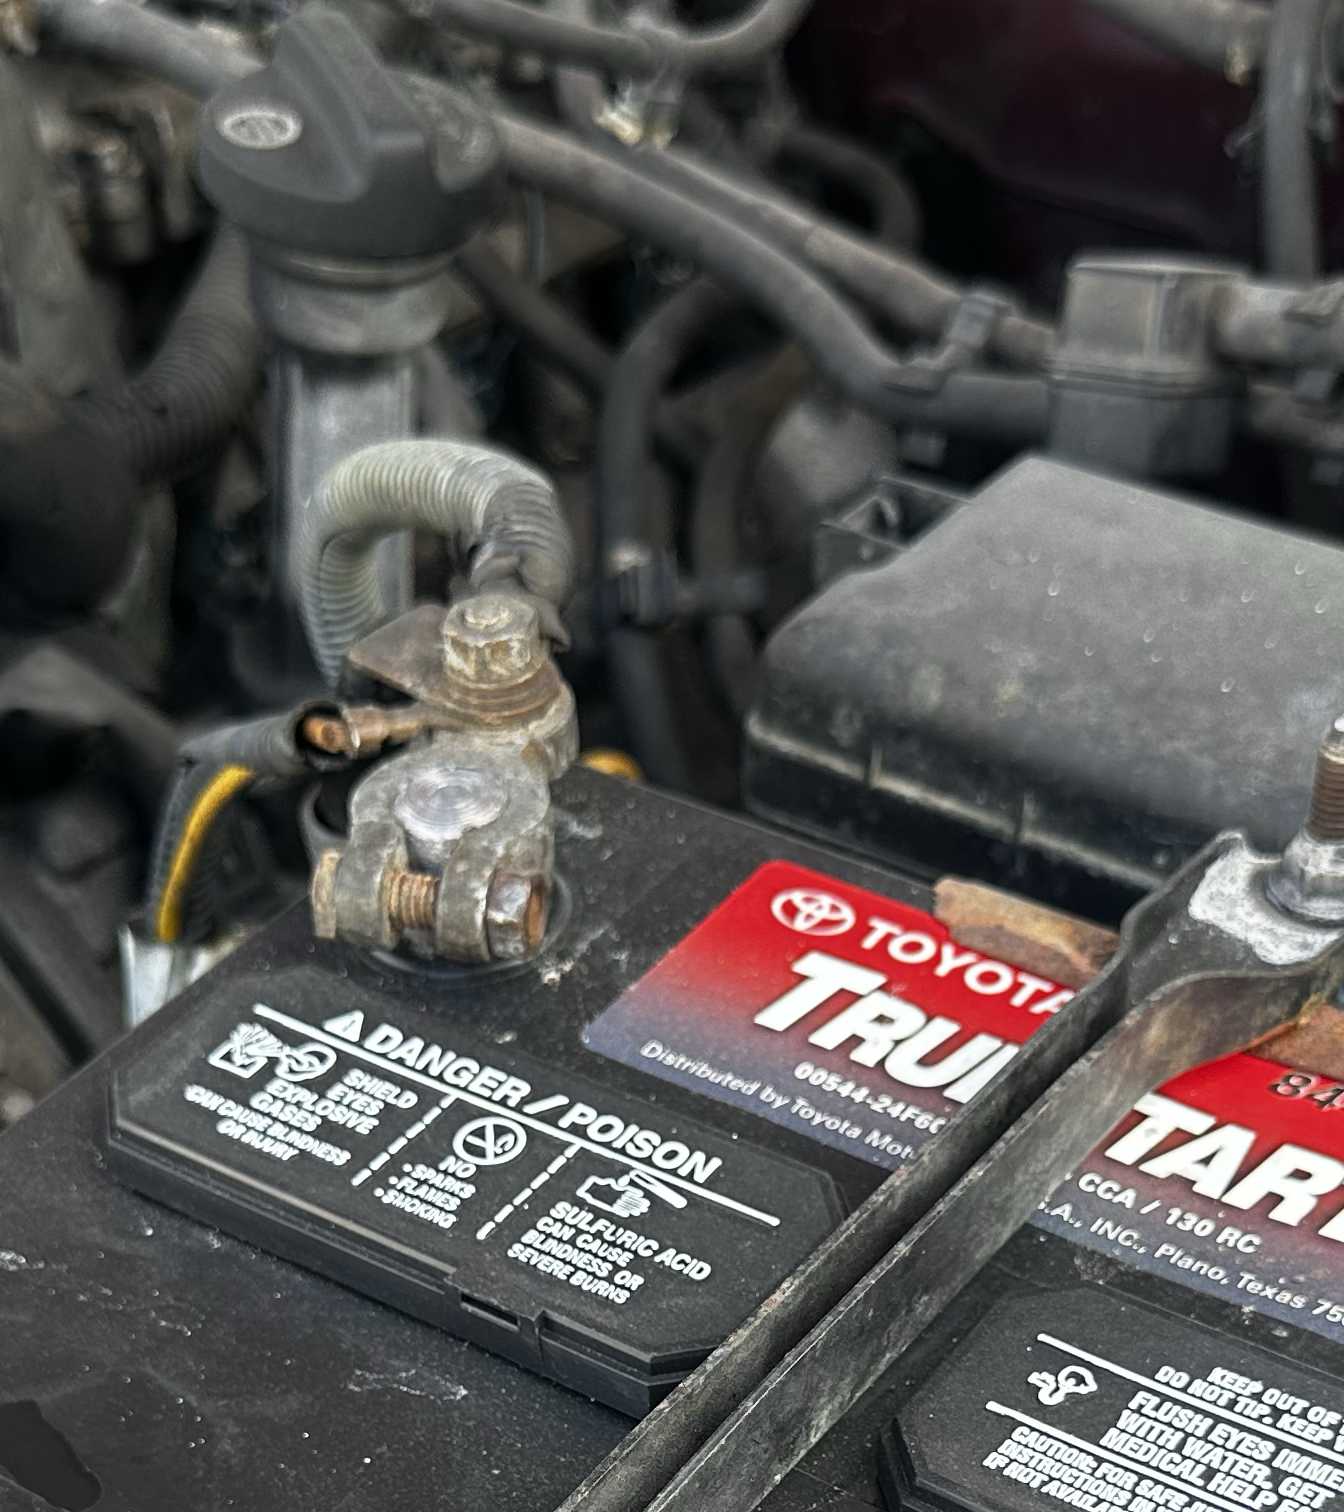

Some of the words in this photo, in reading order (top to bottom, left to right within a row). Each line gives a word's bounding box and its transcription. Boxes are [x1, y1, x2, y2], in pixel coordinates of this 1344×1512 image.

[249, 1091, 322, 1131] GASES
[265, 1078, 379, 1135] EXPLOSIVE
[325, 1082, 385, 1116] EYES
[342, 1068, 418, 1108] SHIELD
[363, 1023, 532, 1109] DANGER
[557, 1102, 723, 1183] POISON
[183, 1084, 222, 1110] CAN
[217, 1098, 272, 1134] CAUSE
[267, 1122, 352, 1166] BLINDNESS
[217, 1118, 242, 1140] OR
[241, 1131, 300, 1161] INJURY
[396, 1176, 461, 1211] FLAMES
[412, 1164, 476, 1199] SPARKS
[438, 1154, 477, 1178] NO
[640, 1039, 762, 1096] Distributed
[760, 1084, 790, 1110] by
[790, 1097, 864, 1139] Toyota
[1154, 1242, 1231, 1285] Plano,
[1236, 1270, 1307, 1310] Texas
[536, 1216, 574, 1240] CAN
[575, 1233, 634, 1268] CAUSE
[550, 1201, 659, 1257] SULFURIC
[654, 1248, 711, 1280] ACID
[1078, 1172, 1137, 1209] CCA
[1165, 1206, 1216, 1238] 130
[1216, 1225, 1262, 1254] RC
[507, 1242, 574, 1280] SEVERE
[570, 1270, 631, 1305] BURNS
[520, 1229, 613, 1277] BLINDNESS
[613, 1269, 644, 1291] OR
[1127, 1391, 1214, 1438] FLUSH
[1208, 1422, 1276, 1461] EYES
[1154, 1365, 1190, 1389] DO
[1187, 1377, 1236, 1407] NOT
[1233, 1395, 1274, 1425] TIP.
[1275, 1413, 1335, 1444] KEEP
[1207, 1367, 1264, 1396] KEEP
[1261, 1388, 1310, 1415] OUT
[1307, 1406, 1343, 1427] OF
[982, 1451, 1009, 1471] IF
[1003, 1462, 1050, 1489] NOT
[997, 1439, 1132, 1507] INSTRUCTIONS
[1010, 1425, 1097, 1474] CAUTION:
[1093, 1462, 1139, 1491] FOR
[1134, 1478, 1190, 1510] SAFE
[1099, 1427, 1206, 1487] MEDICAL
[1206, 1472, 1278, 1511] HELP
[1116, 1409, 1185, 1451] WITH
[1181, 1436, 1273, 1490] WATER.
[1277, 1476, 1336, 1509] GET
